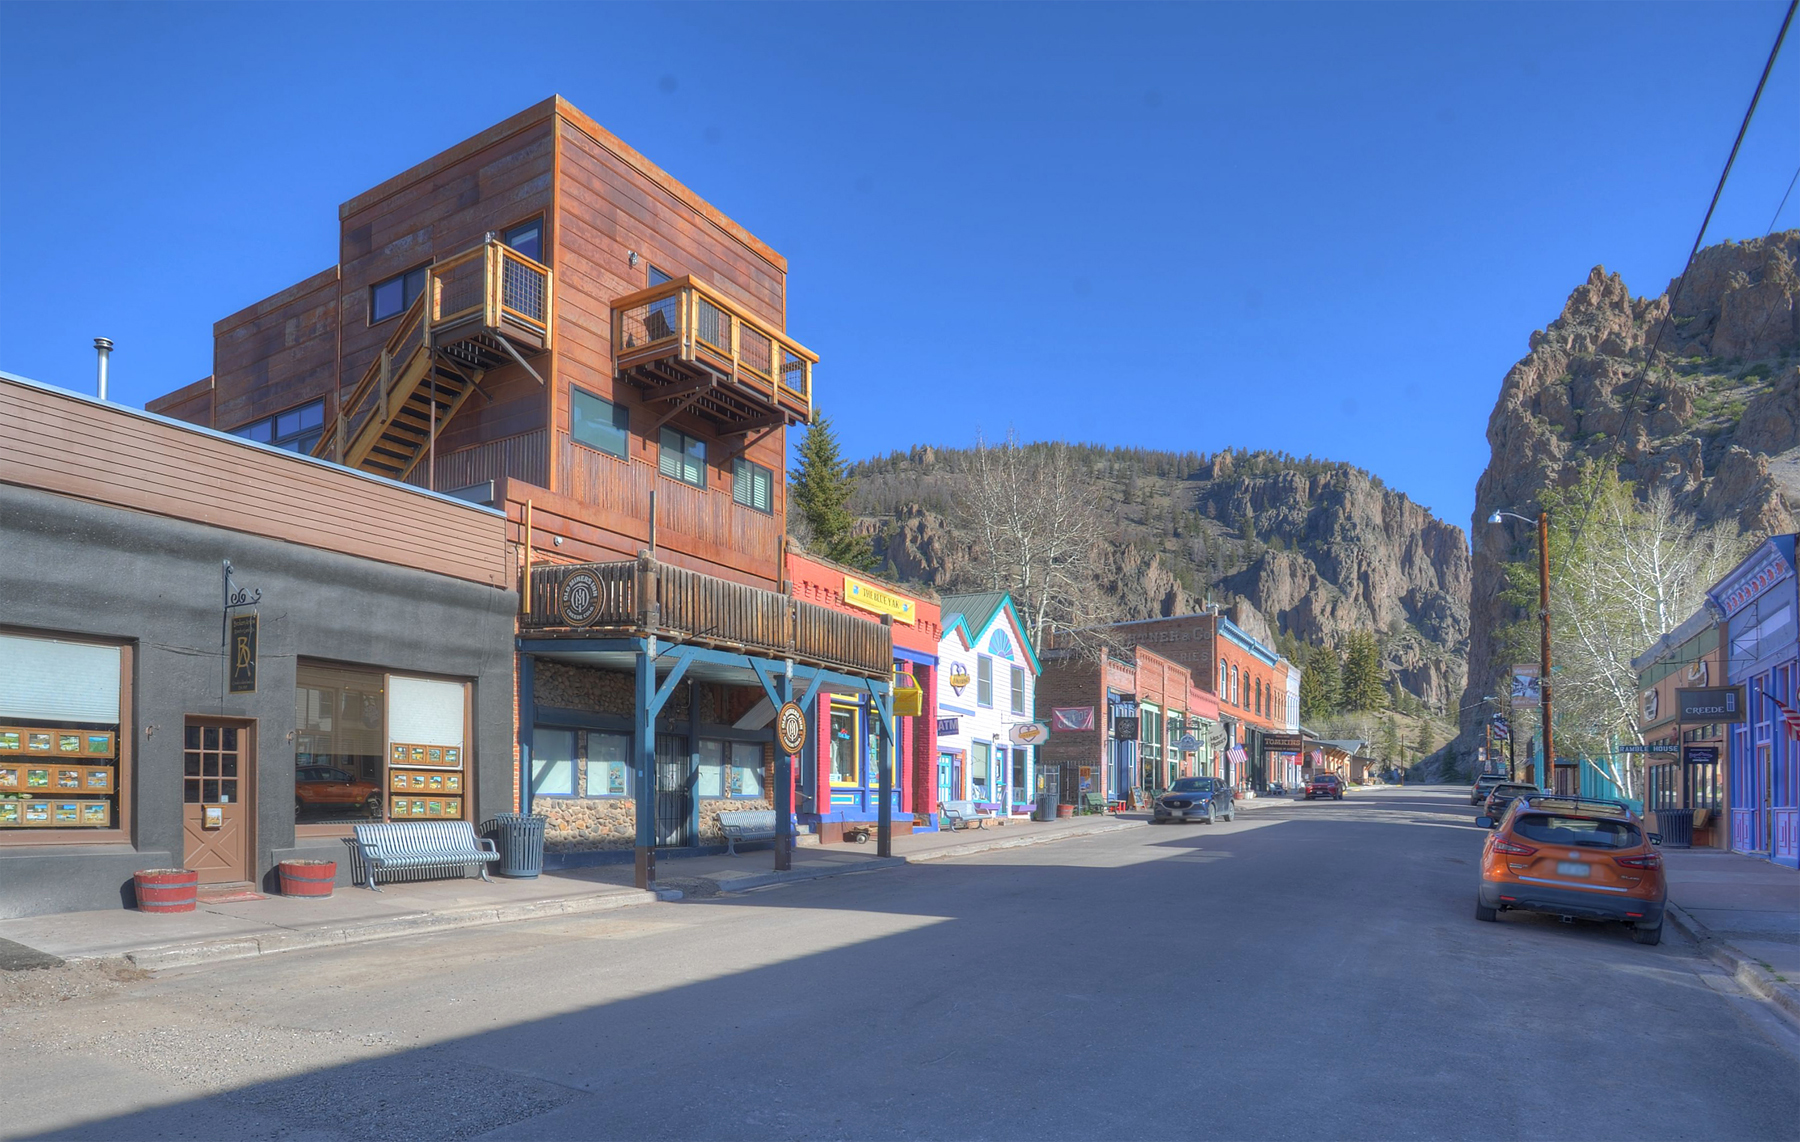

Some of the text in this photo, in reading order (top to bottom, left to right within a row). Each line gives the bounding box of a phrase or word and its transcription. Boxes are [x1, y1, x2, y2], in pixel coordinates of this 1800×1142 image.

[569, 576, 592, 587] MINERS
[887, 597, 900, 609] YAK
[1685, 706, 1725, 715] CREEDE
[938, 719, 958, 731] ATM
[1265, 738, 1300, 746] TOMKINS
